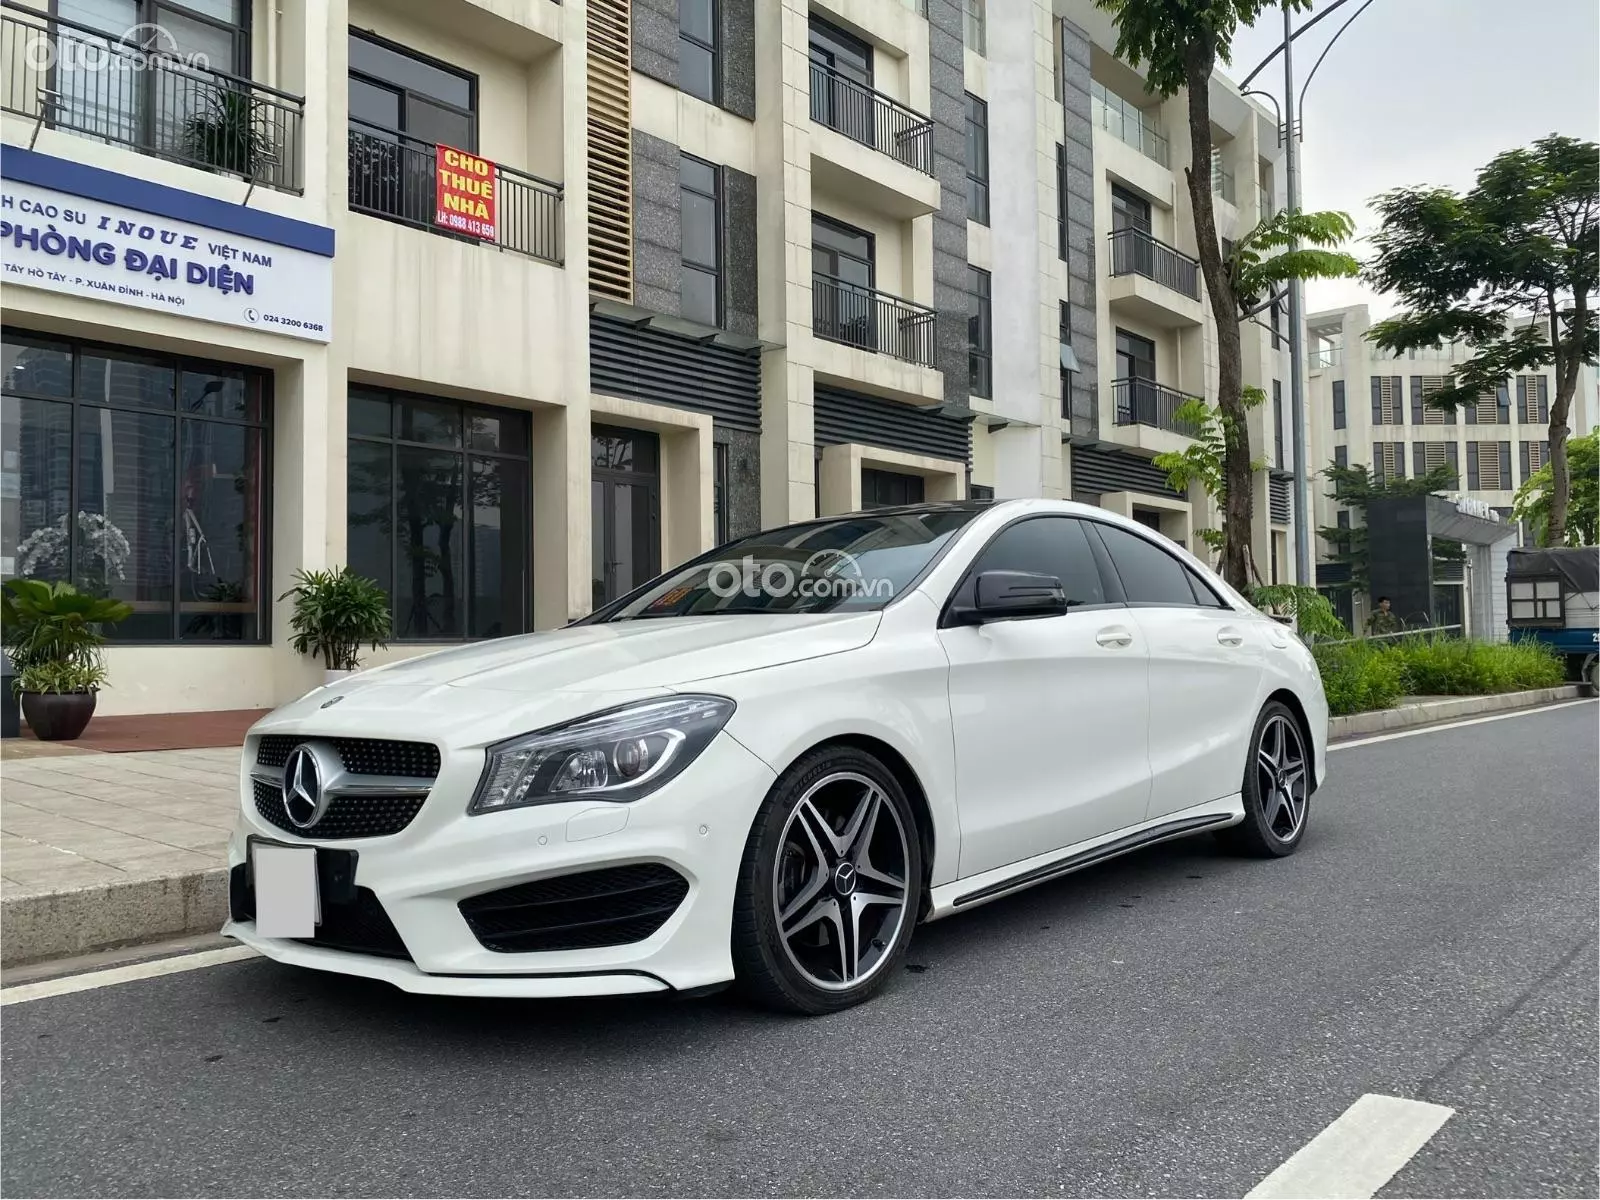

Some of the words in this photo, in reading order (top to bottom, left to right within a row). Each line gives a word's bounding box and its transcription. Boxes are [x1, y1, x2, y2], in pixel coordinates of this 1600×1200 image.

[444, 149, 489, 177] CHO
[438, 168, 494, 200] THUÊ
[437, 210, 448, 224] LH:
[443, 192, 490, 220] NHÀ
[19, 199, 59, 218] CAO
[63, 209, 86, 225] SU
[97, 215, 199, 250] INOUE
[208, 242, 239, 260] VIỆT
[242, 251, 272, 268] NAM
[124, 248, 178, 282] ĐẠI
[186, 261, 254, 295] DIỆN
[47, 271, 66, 282] TÂY
[151, 292, 166, 302] HÀ
[167, 295, 185, 307] NỘI
[263, 313, 279, 323] 024
[280, 317, 302, 328] 3200
[303, 321, 324, 332] 6368
